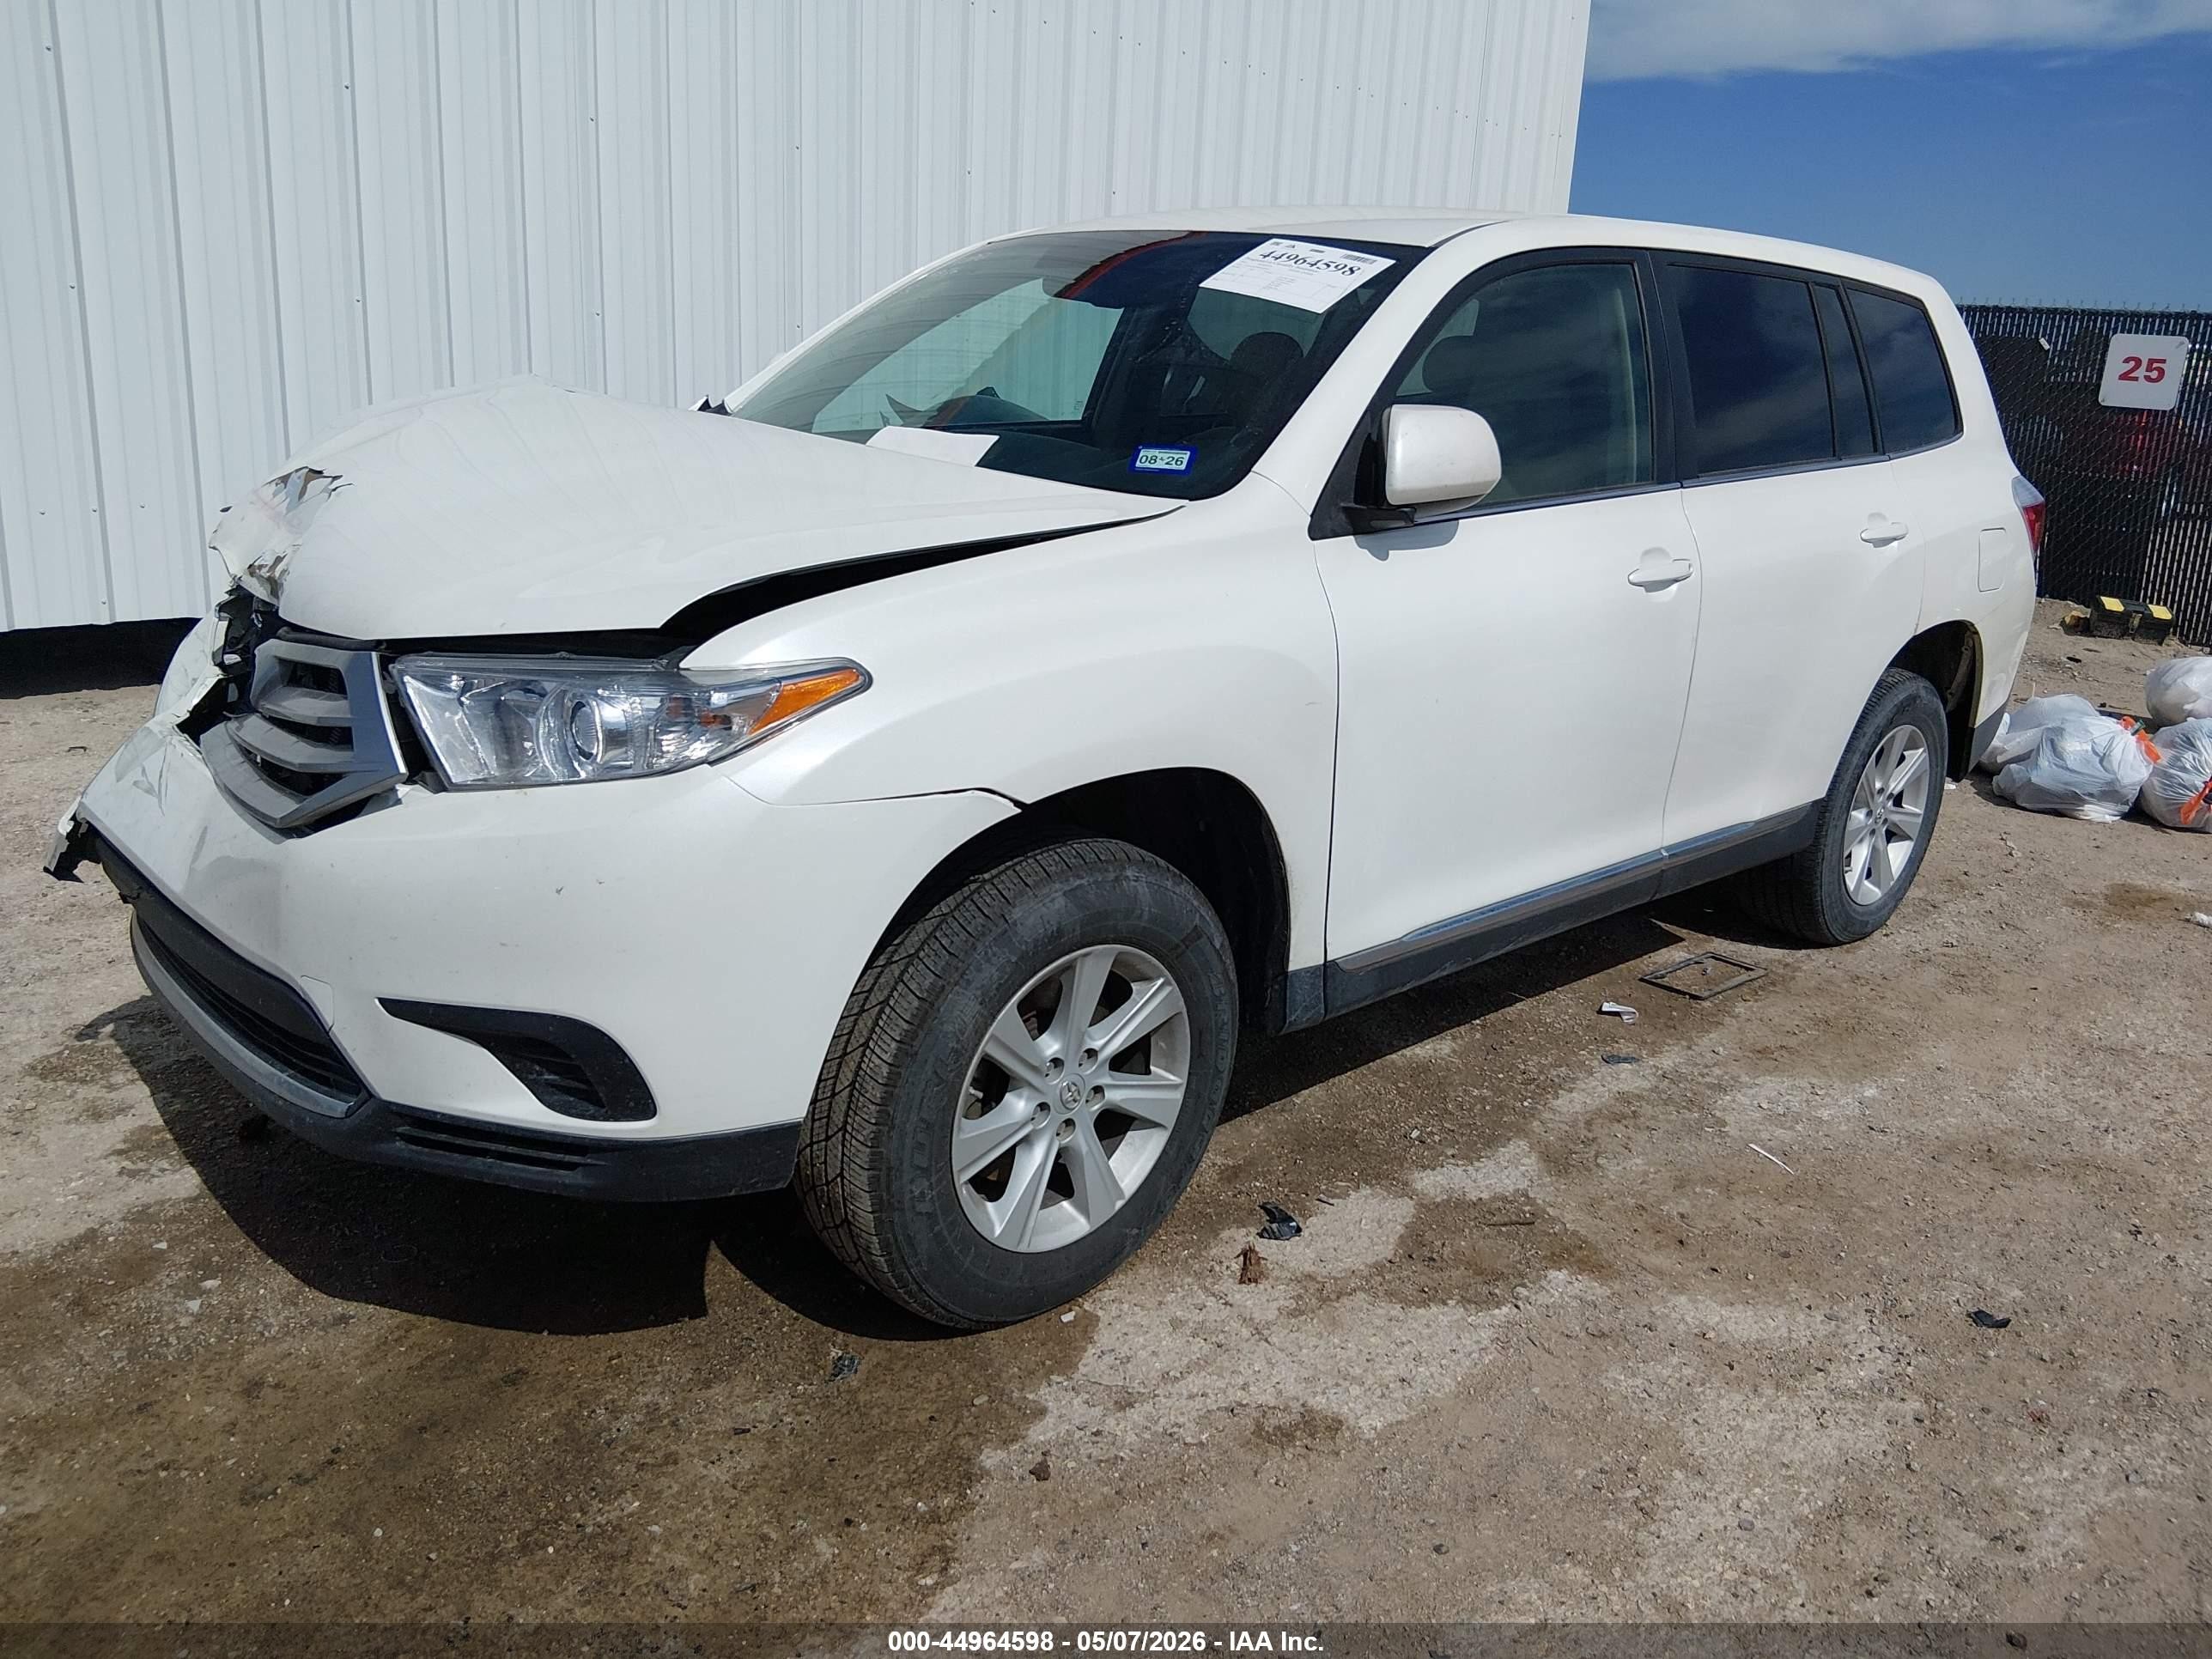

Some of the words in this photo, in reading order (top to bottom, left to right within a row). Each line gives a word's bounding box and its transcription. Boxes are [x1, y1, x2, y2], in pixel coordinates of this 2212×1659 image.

[1260, 250, 1361, 276] 44964598
[2118, 356, 2166, 383] 25
[1139, 454, 1158, 465] 08
[1164, 456, 1185, 466] 26
